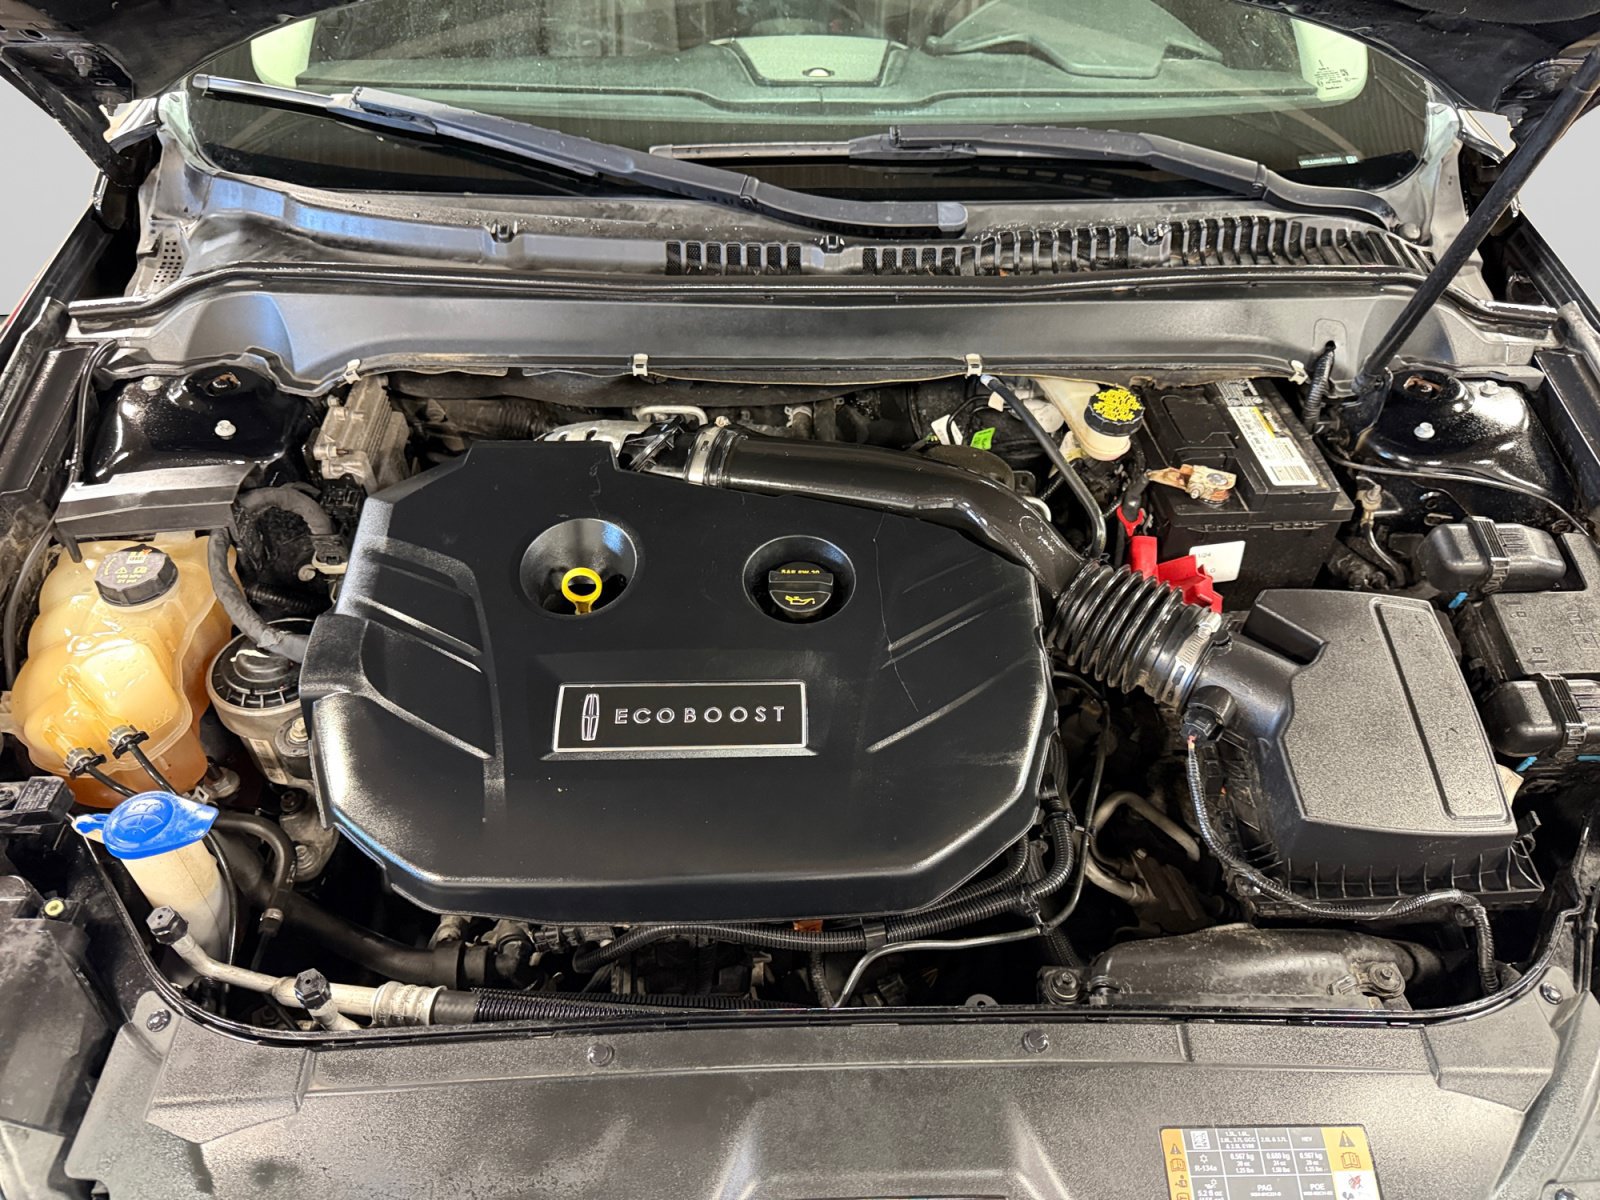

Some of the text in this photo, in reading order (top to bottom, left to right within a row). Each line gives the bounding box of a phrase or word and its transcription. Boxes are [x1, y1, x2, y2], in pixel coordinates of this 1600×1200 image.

[614, 706, 785, 724] ECOBOOST
[1246, 1153, 1254, 1161] kg
[1282, 1152, 1291, 1161] kg
[1315, 1152, 1323, 1160] kg
